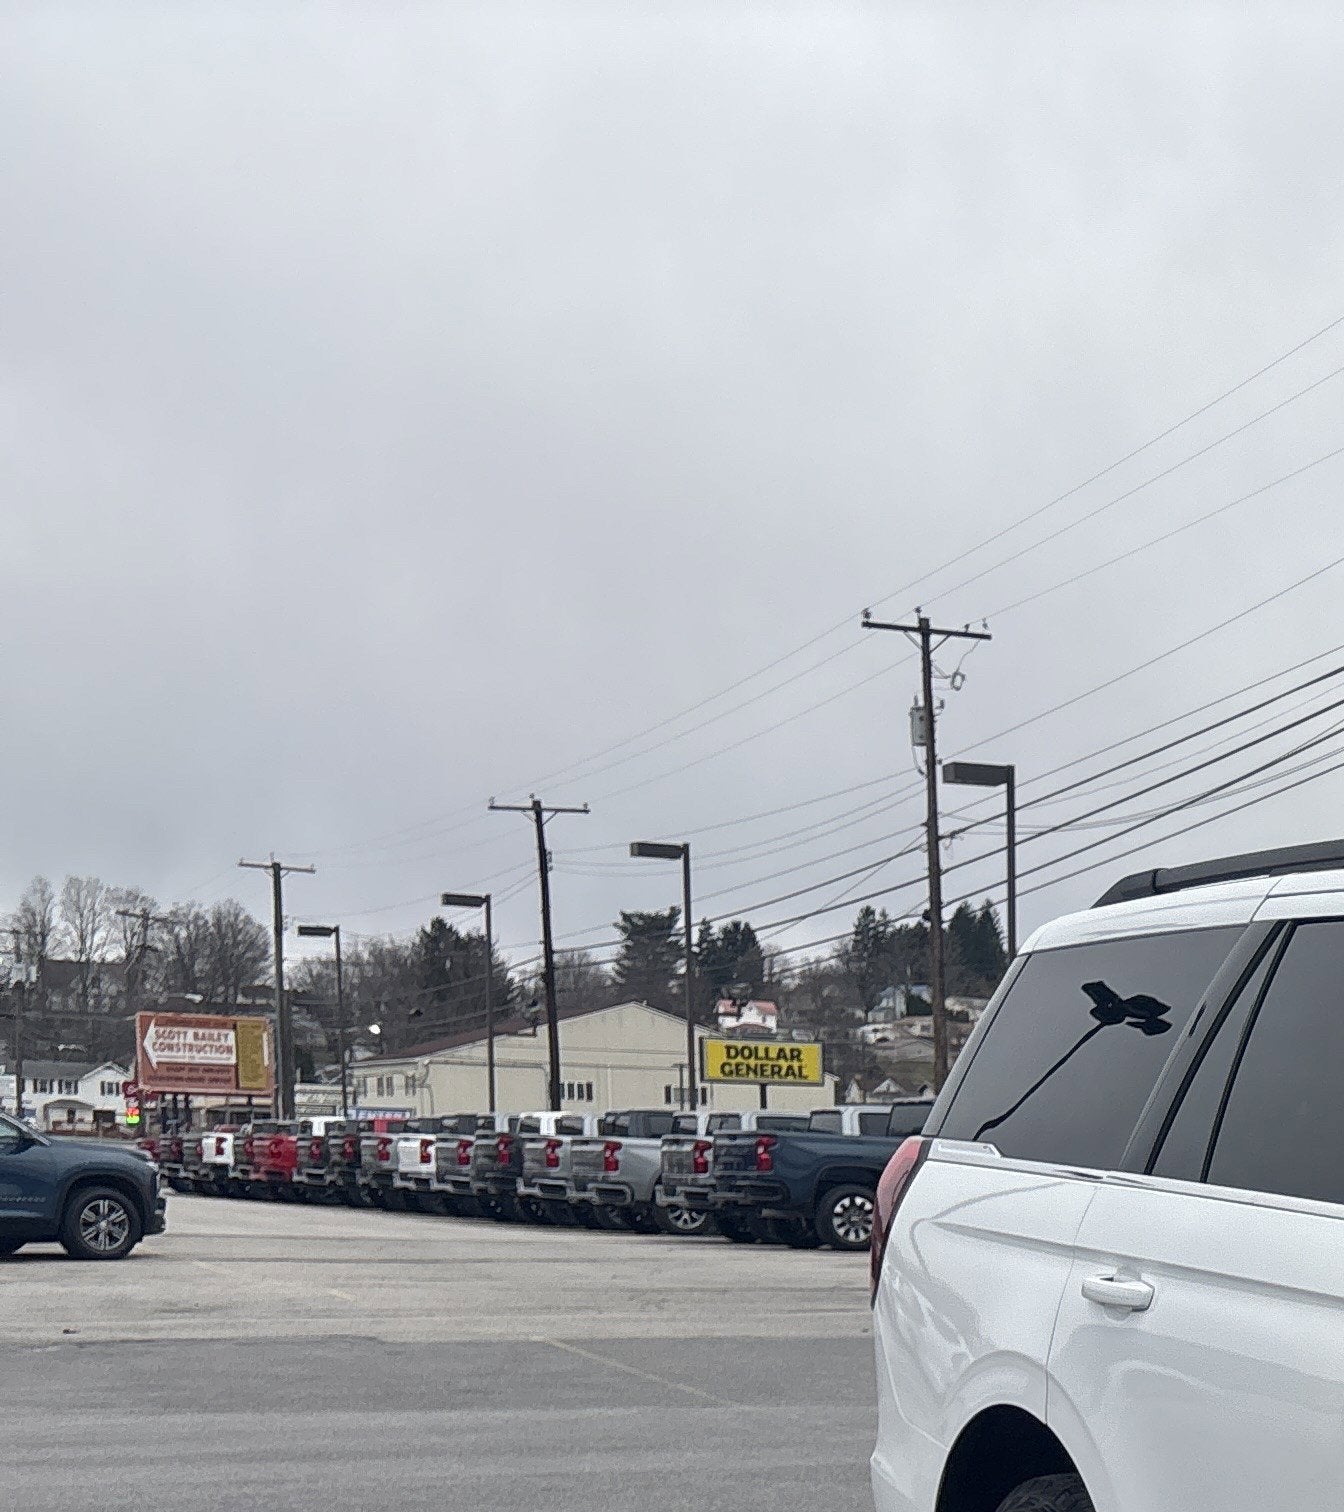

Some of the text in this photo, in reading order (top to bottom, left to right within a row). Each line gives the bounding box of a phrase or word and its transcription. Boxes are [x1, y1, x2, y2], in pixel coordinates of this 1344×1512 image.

[154, 1029, 188, 1042] SCOTT
[152, 1041, 234, 1056] CONSTRUCTION
[724, 1044, 804, 1062] DOLLAR
[720, 1061, 809, 1079] GENERAL
